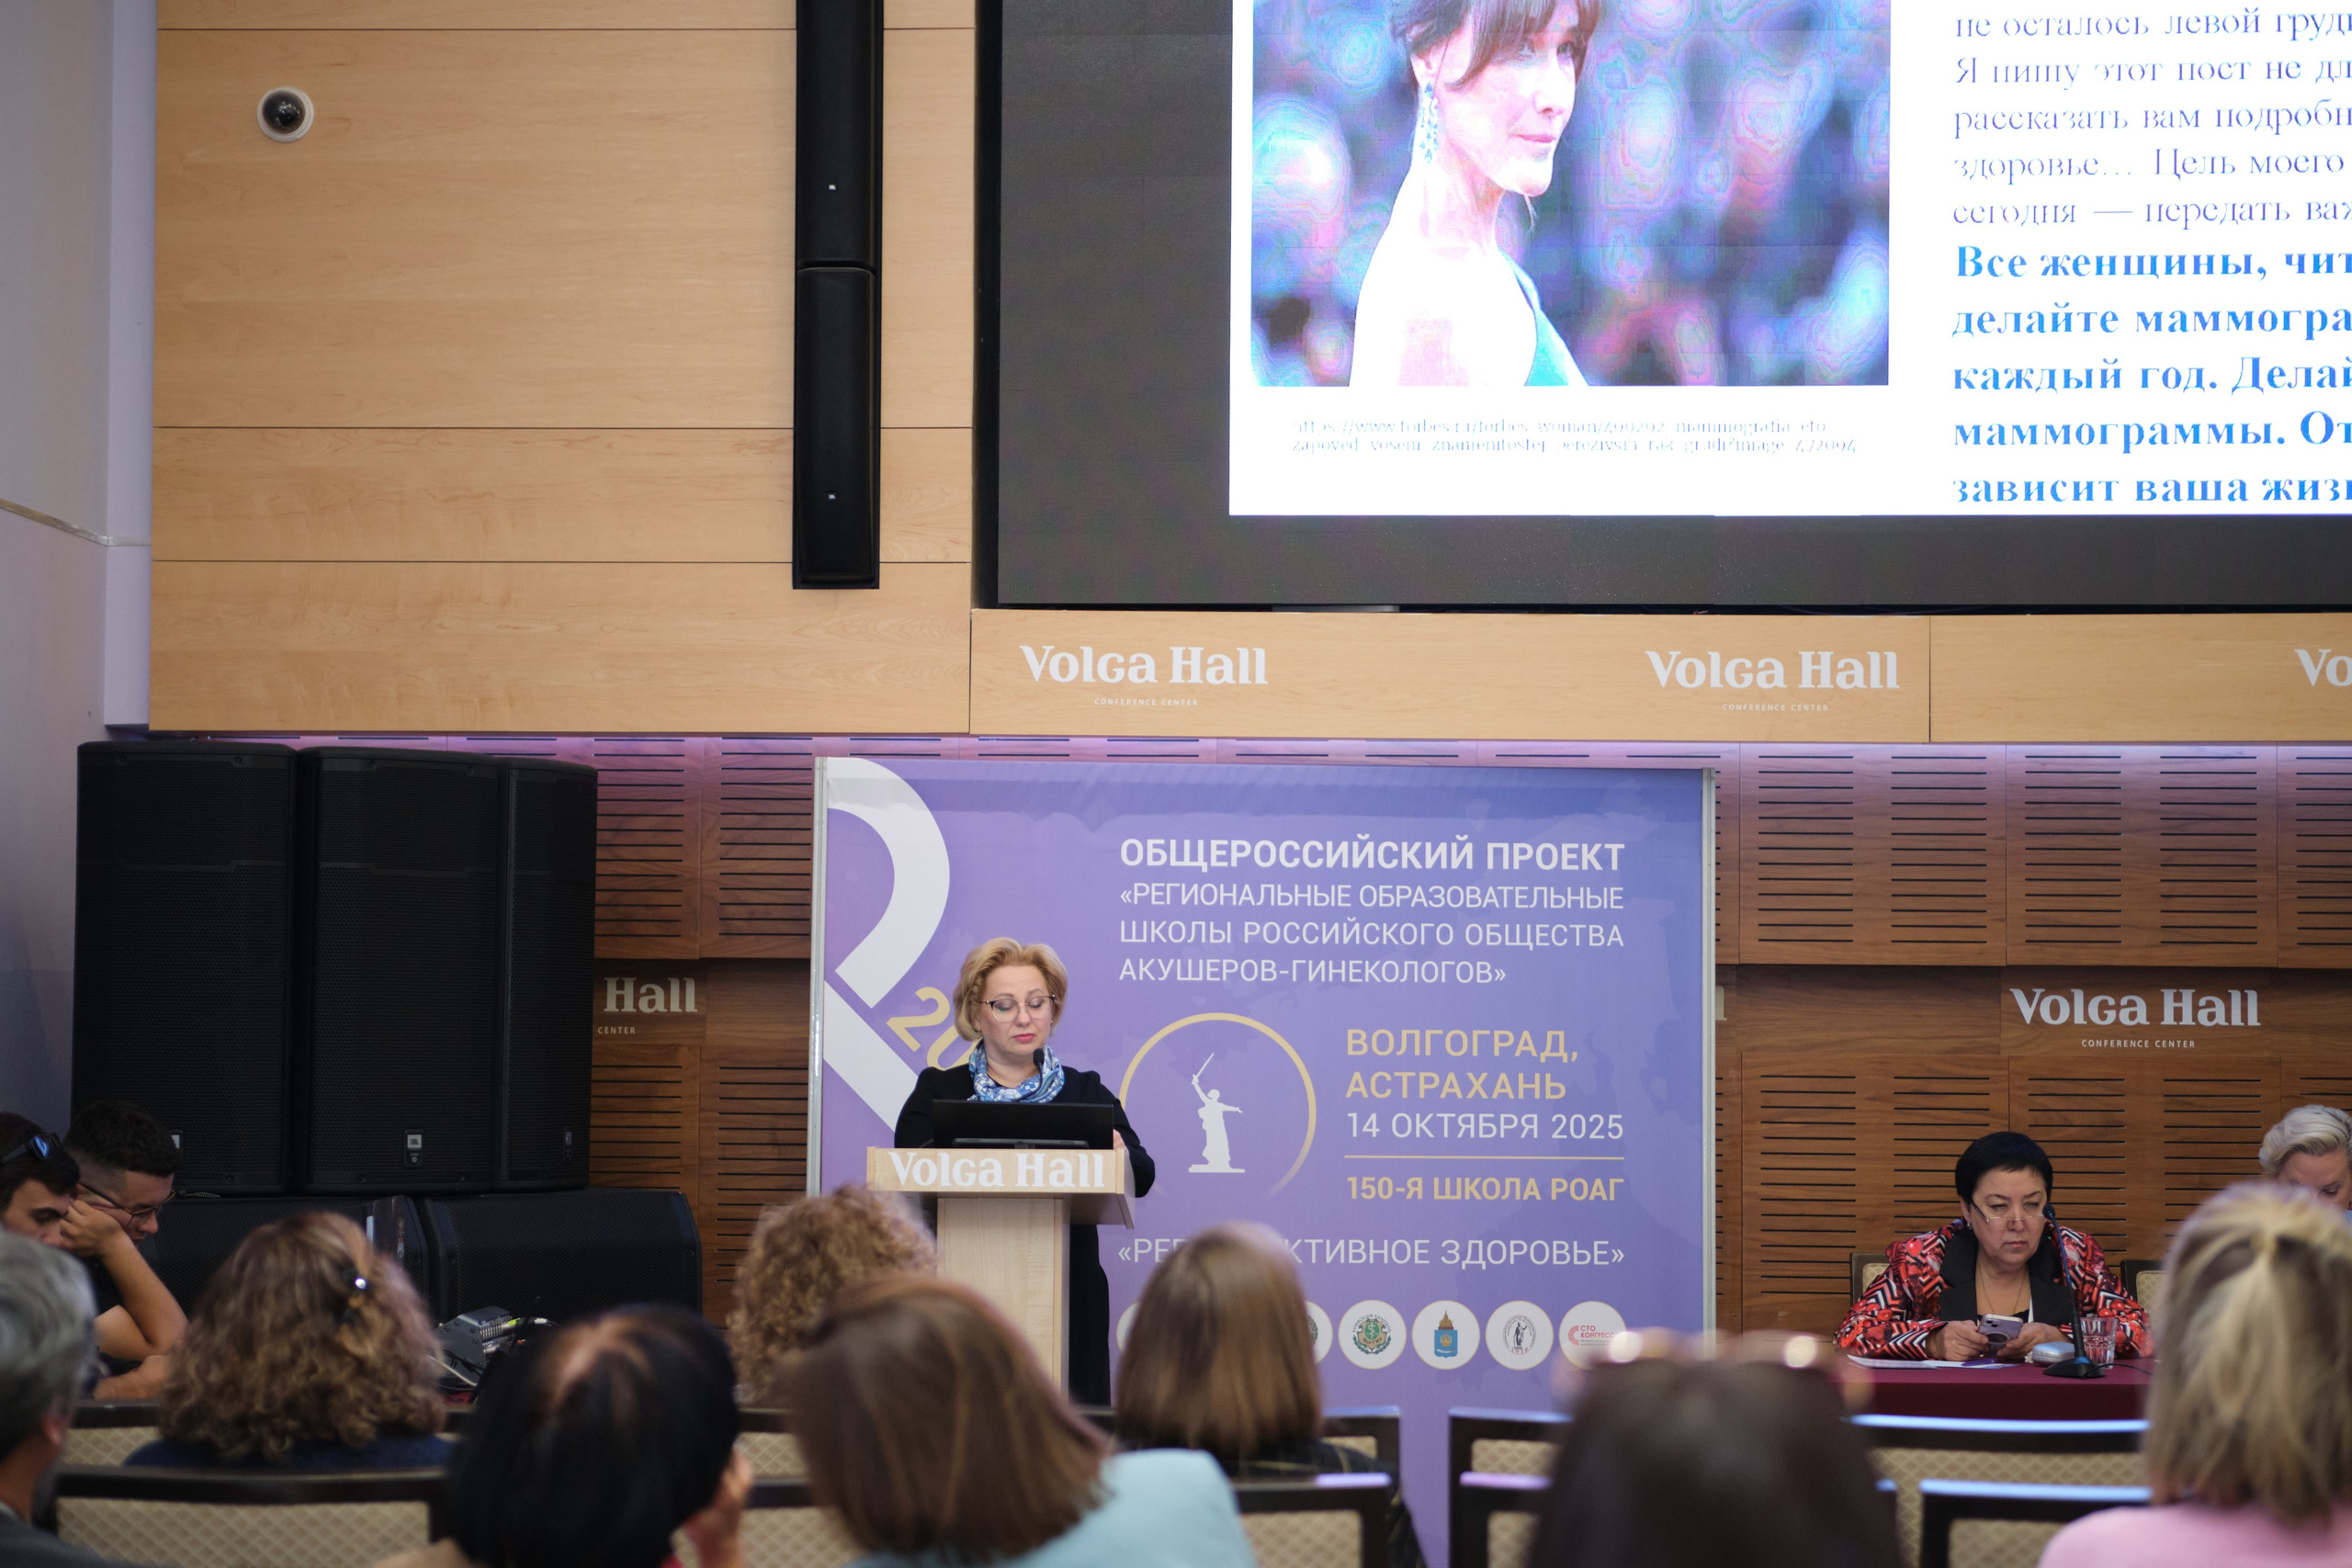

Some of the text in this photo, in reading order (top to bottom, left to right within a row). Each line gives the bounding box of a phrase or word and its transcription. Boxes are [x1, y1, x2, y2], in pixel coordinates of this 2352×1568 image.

[1957, 19, 1990, 37] не
[2004, 17, 2149, 36] осталось
[2165, 7, 2260, 34] левой
[1956, 57, 1976, 83] Я
[1994, 64, 2079, 90] пишу
[2095, 63, 2163, 81] этот
[2177, 62, 2251, 80] пост
[2266, 62, 2301, 79] не
[1954, 110, 2128, 139] рассказать
[2143, 109, 2199, 128] вам
[2155, 149, 2235, 181] Цель
[2250, 155, 2344, 174] моего
[1953, 205, 2075, 227] сегодня
[2146, 203, 2290, 230] передать
[1957, 246, 2027, 277] Все
[2041, 254, 2267, 280] женщины,
[1952, 301, 2352, 341] делайте маммогра
[1954, 358, 2121, 393] каждый
[2141, 367, 2217, 393] год.
[1955, 423, 2285, 454] маммограммы.
[1953, 480, 2119, 502] зависит
[2135, 479, 2249, 502] ваша
[1169, 647, 1268, 684] Hall
[1799, 651, 1899, 689] Hall
[1121, 834, 1624, 873] ОБЩЕРОССИЙСКИЙ ПРОЕКТ
[1121, 883, 1623, 908] «РЕГИОНАЛЬНЫЕ ОБРАЗОВАТЕЛЬНЫЕ
[1121, 917, 1623, 951] ШКОЛЫ РОССИЙСКОГО ОБЩЕСТВА
[1119, 959, 1506, 983] АКУШЕРОВ-ГИНЕКОЛОГОВ»
[604, 976, 698, 1013] Hall
[2161, 989, 2260, 1026] Hall
[1348, 1029, 1577, 1063] ВОЛГОГРАД,
[1346, 1072, 1566, 1099] АСТРАХАНЬ
[1348, 1112, 1623, 1139] 14 ОКТЯБРЯ 2025
[1015, 1151, 1104, 1188] Hall
[1348, 1177, 1623, 1201] 150-Я ШКОЛА РОАГ
[1442, 1240, 1624, 1269] ЗДОРОВЬЕ»
